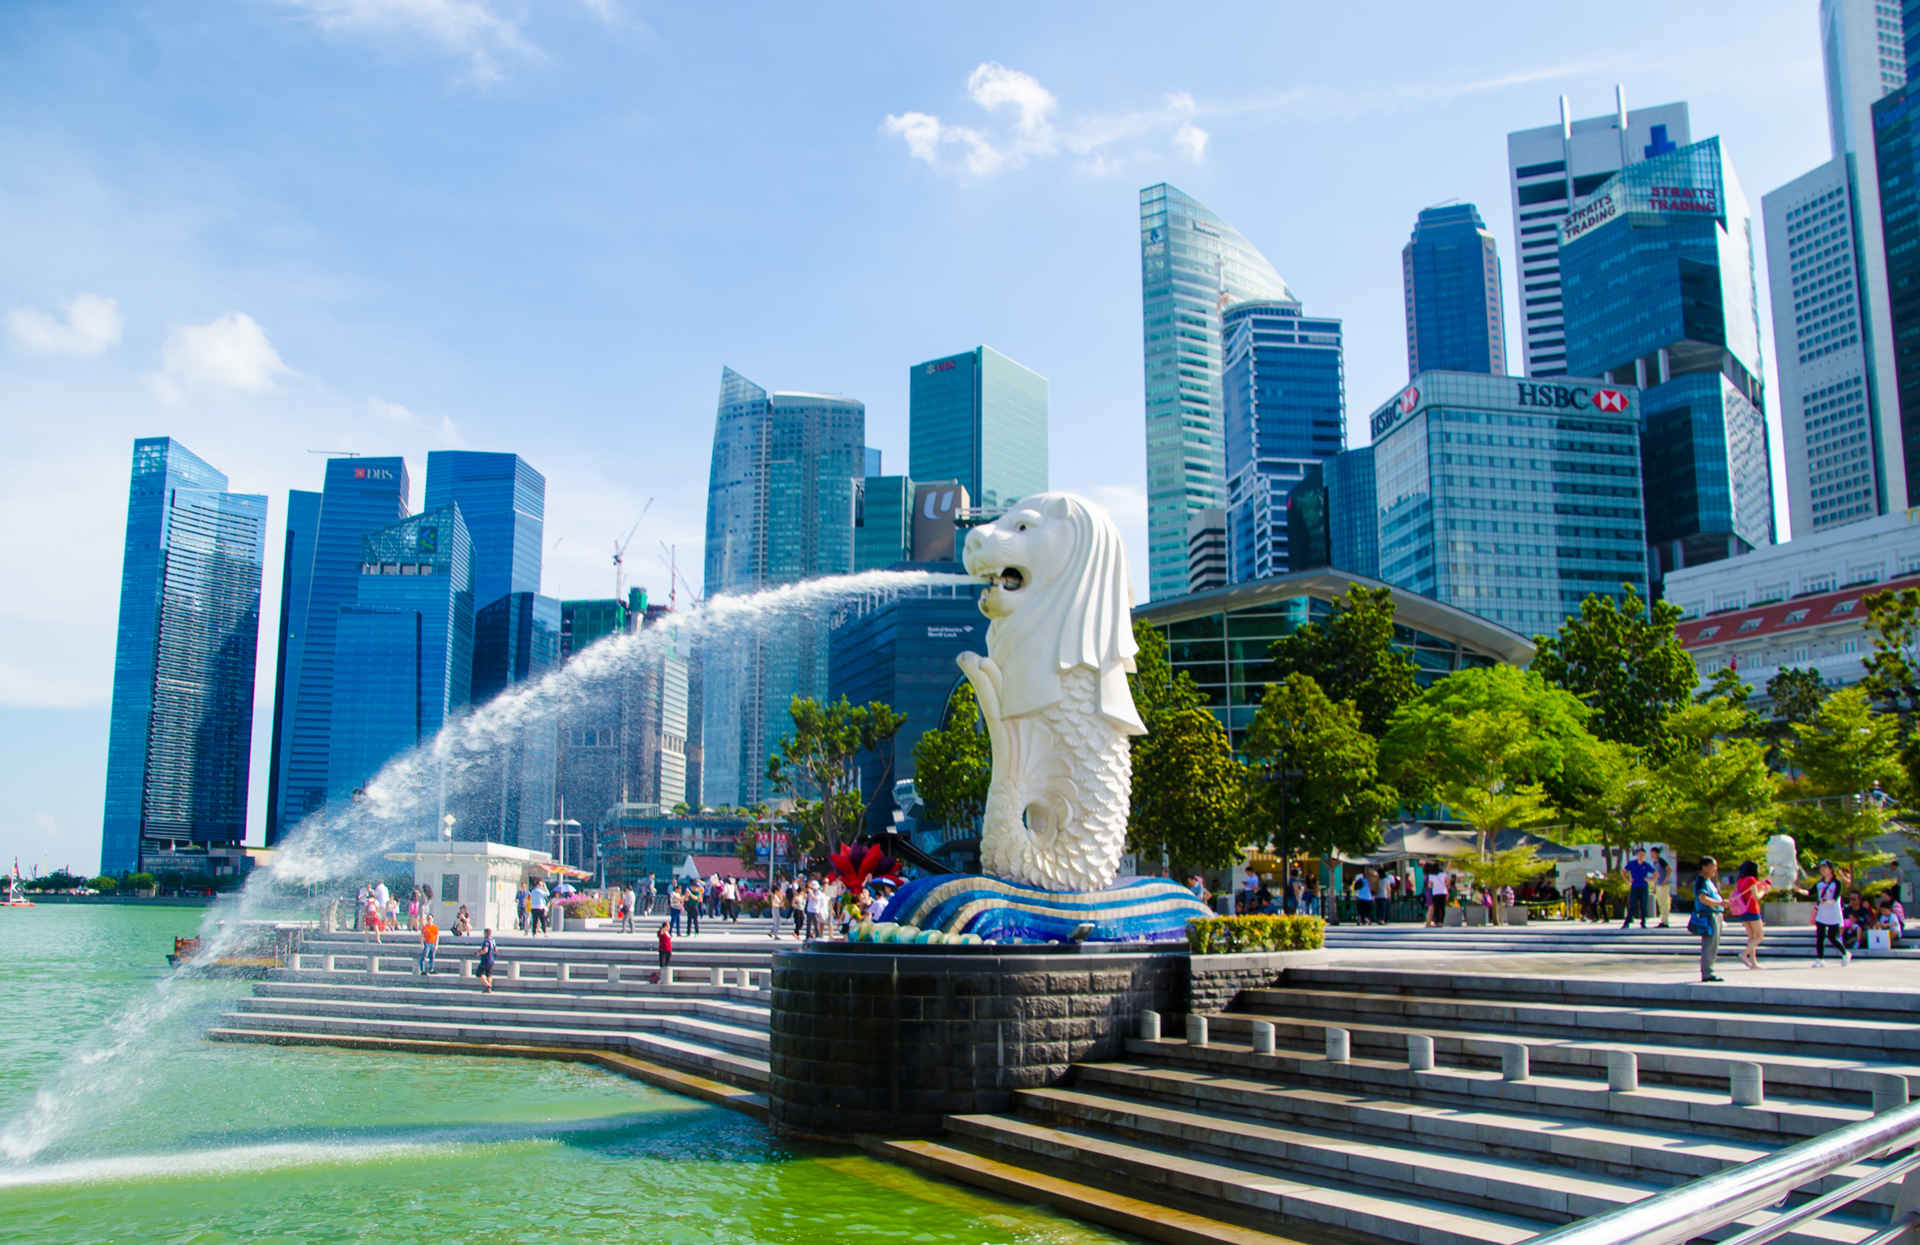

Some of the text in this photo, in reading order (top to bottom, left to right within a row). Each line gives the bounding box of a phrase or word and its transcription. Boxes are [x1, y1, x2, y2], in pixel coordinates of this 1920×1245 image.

[1648, 199, 1716, 212] TRADING
[1652, 186, 1715, 199] STRAITS
[1564, 195, 1612, 226] STRAITS
[1565, 204, 1616, 238] TRADING
[1518, 382, 1588, 410] HSBC
[1370, 397, 1402, 441] HSBC
[367, 468, 393, 480] DBS
